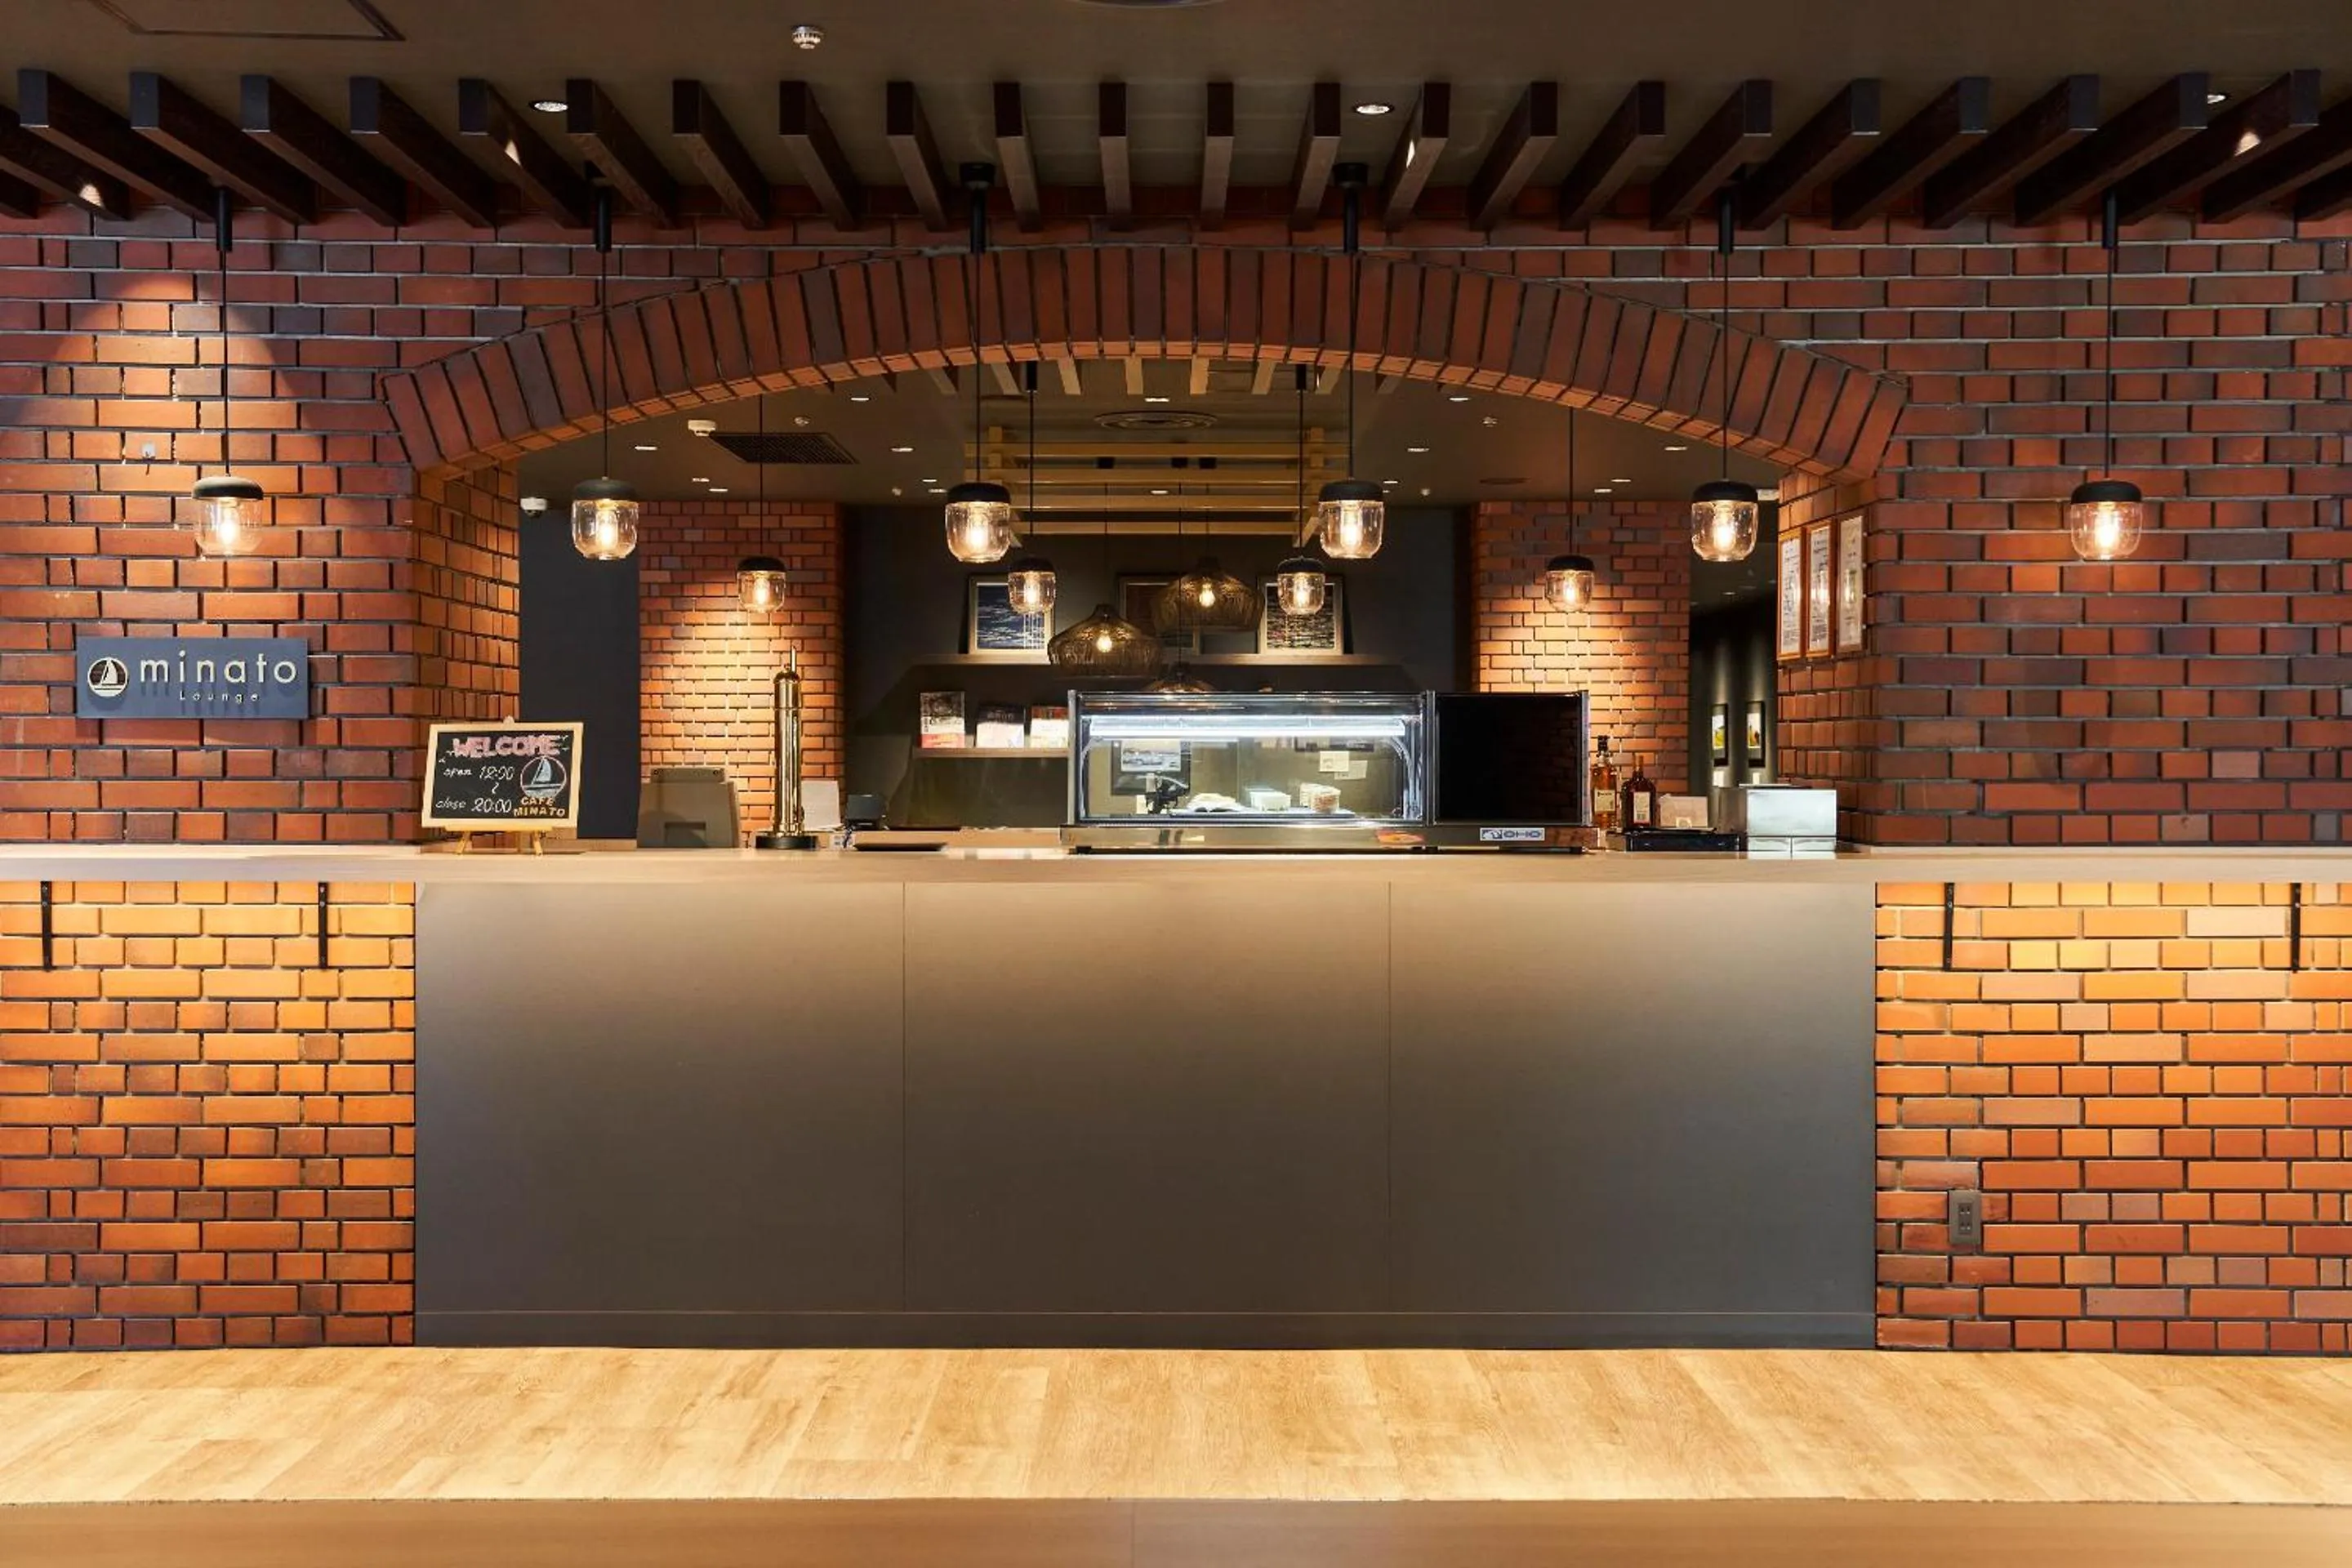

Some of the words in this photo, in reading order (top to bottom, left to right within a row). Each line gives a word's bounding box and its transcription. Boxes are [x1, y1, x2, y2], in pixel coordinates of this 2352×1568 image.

[140, 650, 297, 684] minato
[179, 691, 259, 703] Lounge
[452, 734, 561, 758] WELCOME
[514, 805, 566, 817] MINATO
